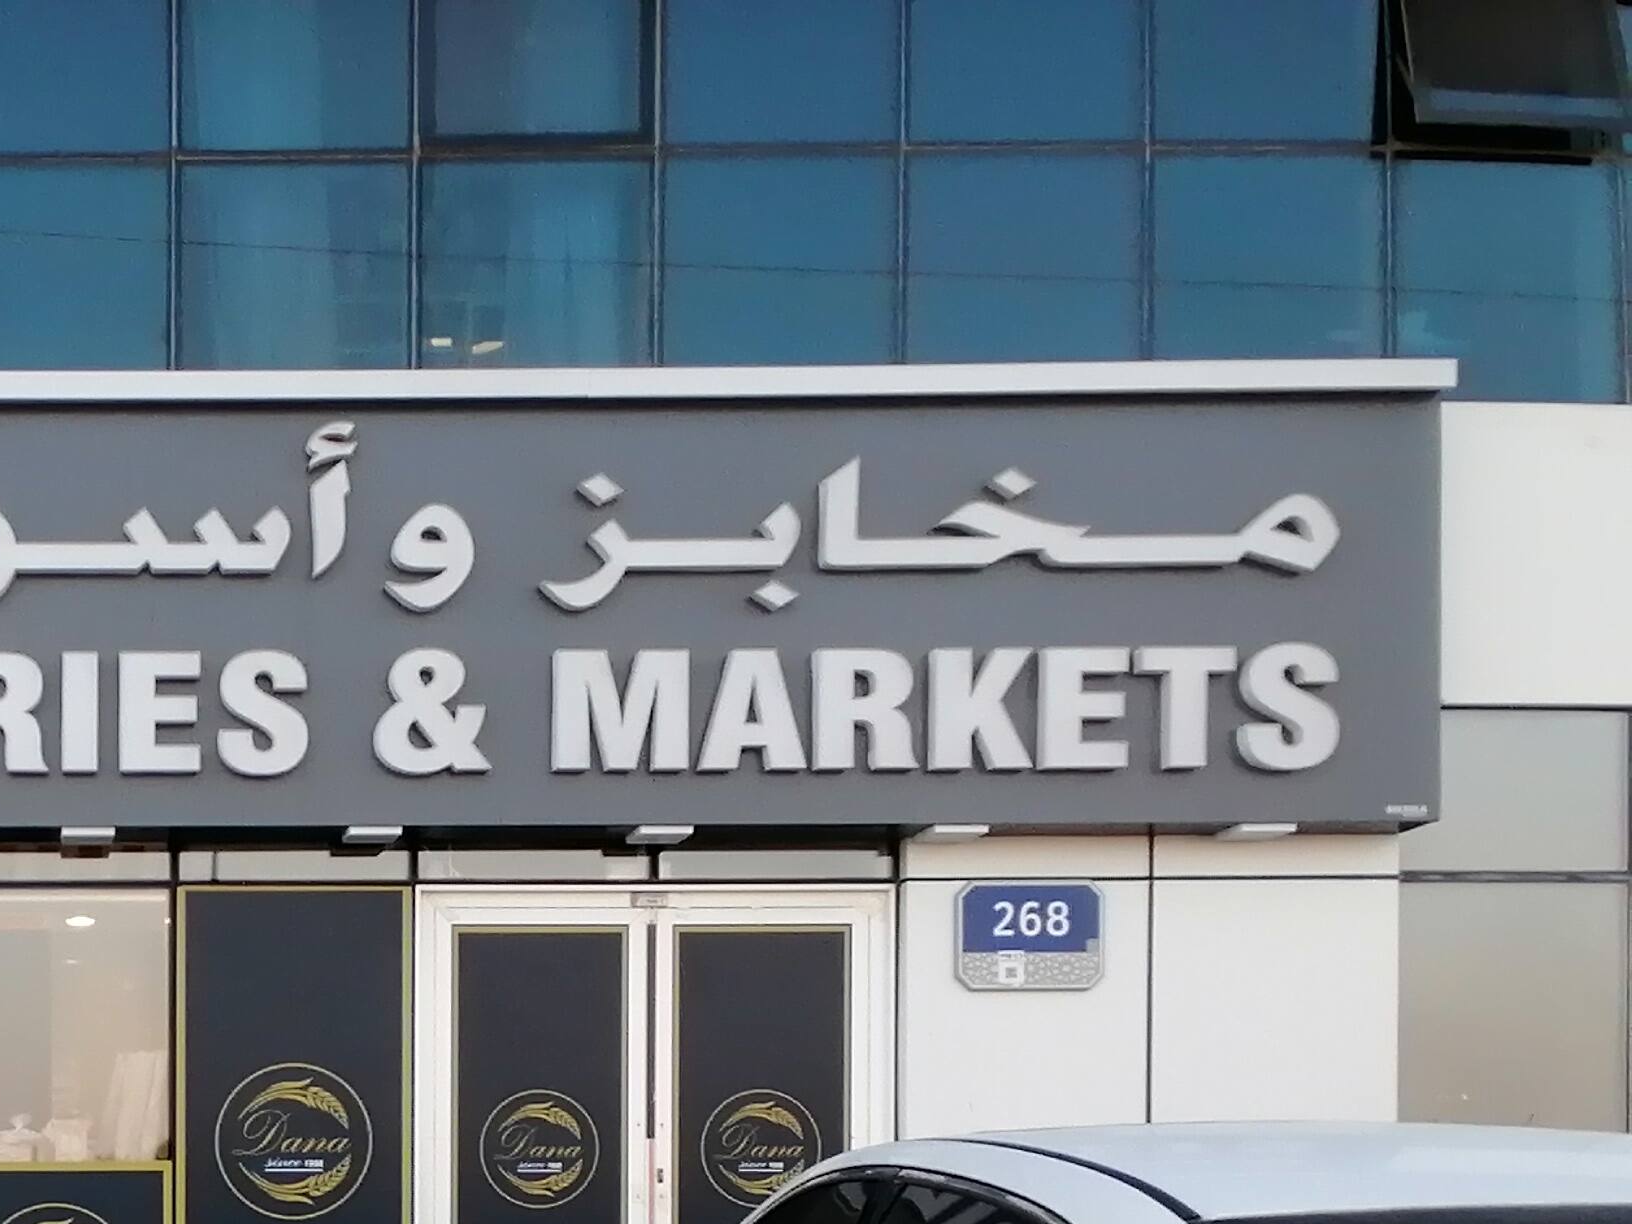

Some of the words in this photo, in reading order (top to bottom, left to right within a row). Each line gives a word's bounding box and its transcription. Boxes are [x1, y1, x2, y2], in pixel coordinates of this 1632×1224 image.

[539, 456, 1340, 610] مخابز
[372, 648, 492, 777] &
[549, 642, 1340, 774] MARKETS
[992, 900, 1070, 937] 268
[232, 1109, 352, 1156] Dana
